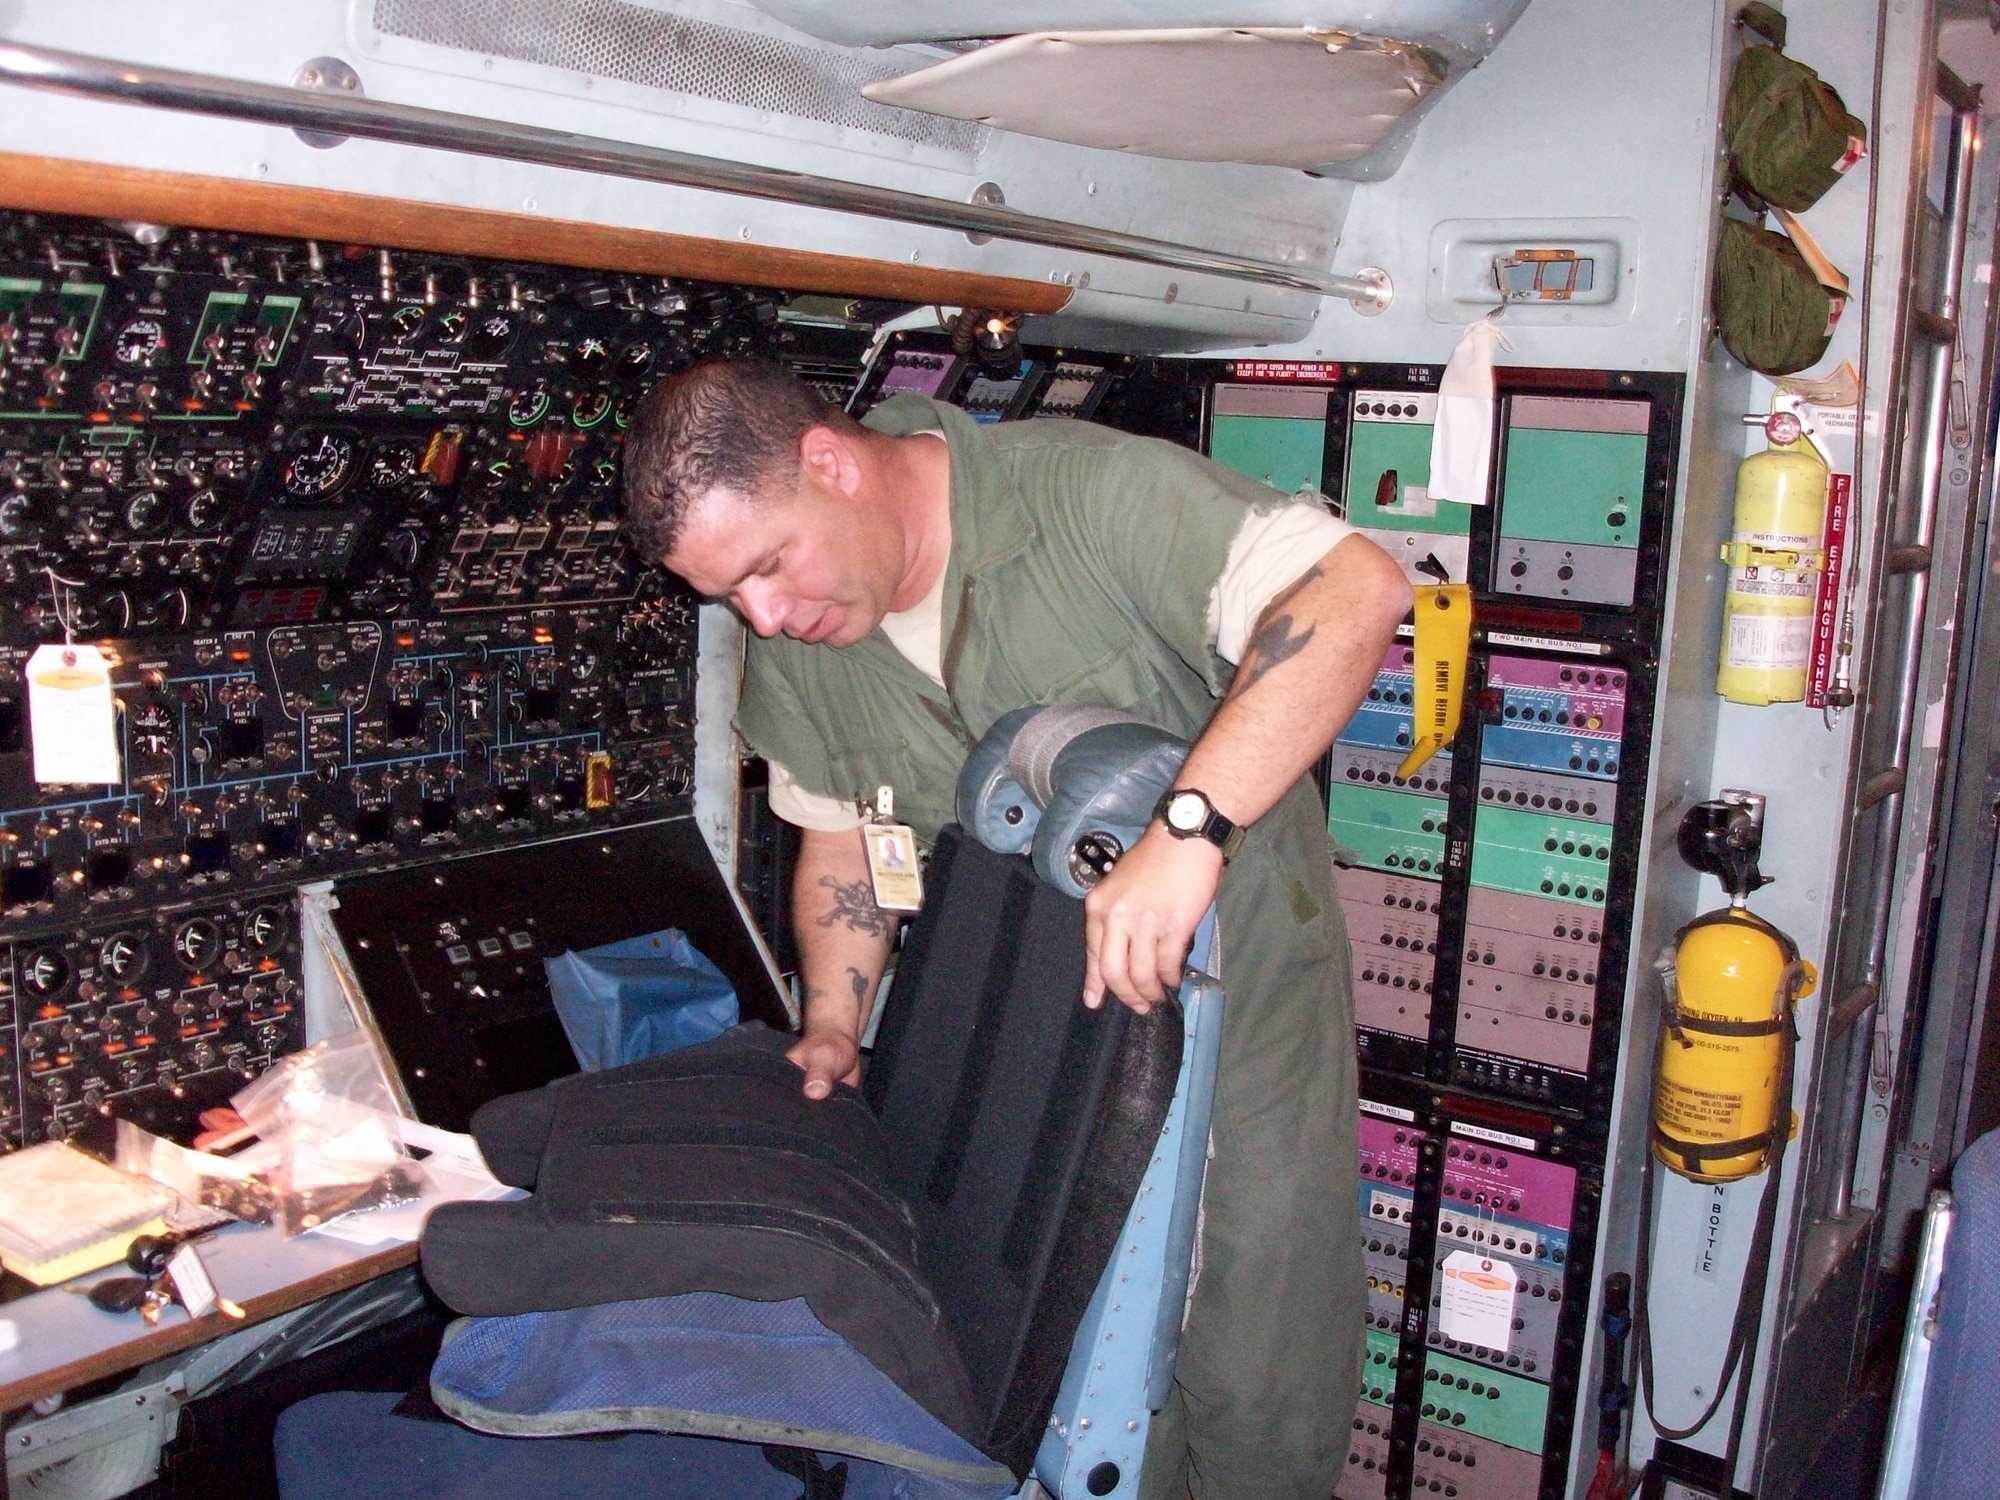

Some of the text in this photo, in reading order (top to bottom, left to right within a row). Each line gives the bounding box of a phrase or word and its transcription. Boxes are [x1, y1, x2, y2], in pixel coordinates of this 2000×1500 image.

[1817, 412, 1871, 421] PORTABLE OXEN
[1831, 478, 1844, 532] FIRE
[1752, 532, 1809, 544] INSTRUCTIONS
[1812, 545, 1838, 706] EXTINGUISHER
[1494, 633, 1582, 649] FWD MAIN AC BUS NO.1
[1435, 660, 1450, 693] REMOVE
[1434, 698, 1448, 727] BEFORE
[1701, 1011, 1729, 1022] OXYGEN
[1369, 1103, 1385, 1113] BUS
[1385, 1107, 1401, 1116] NO.1
[1455, 1124, 1521, 1144] MAIN DC BUS NO.1
[1702, 1203, 1722, 1273] BOTTLE
